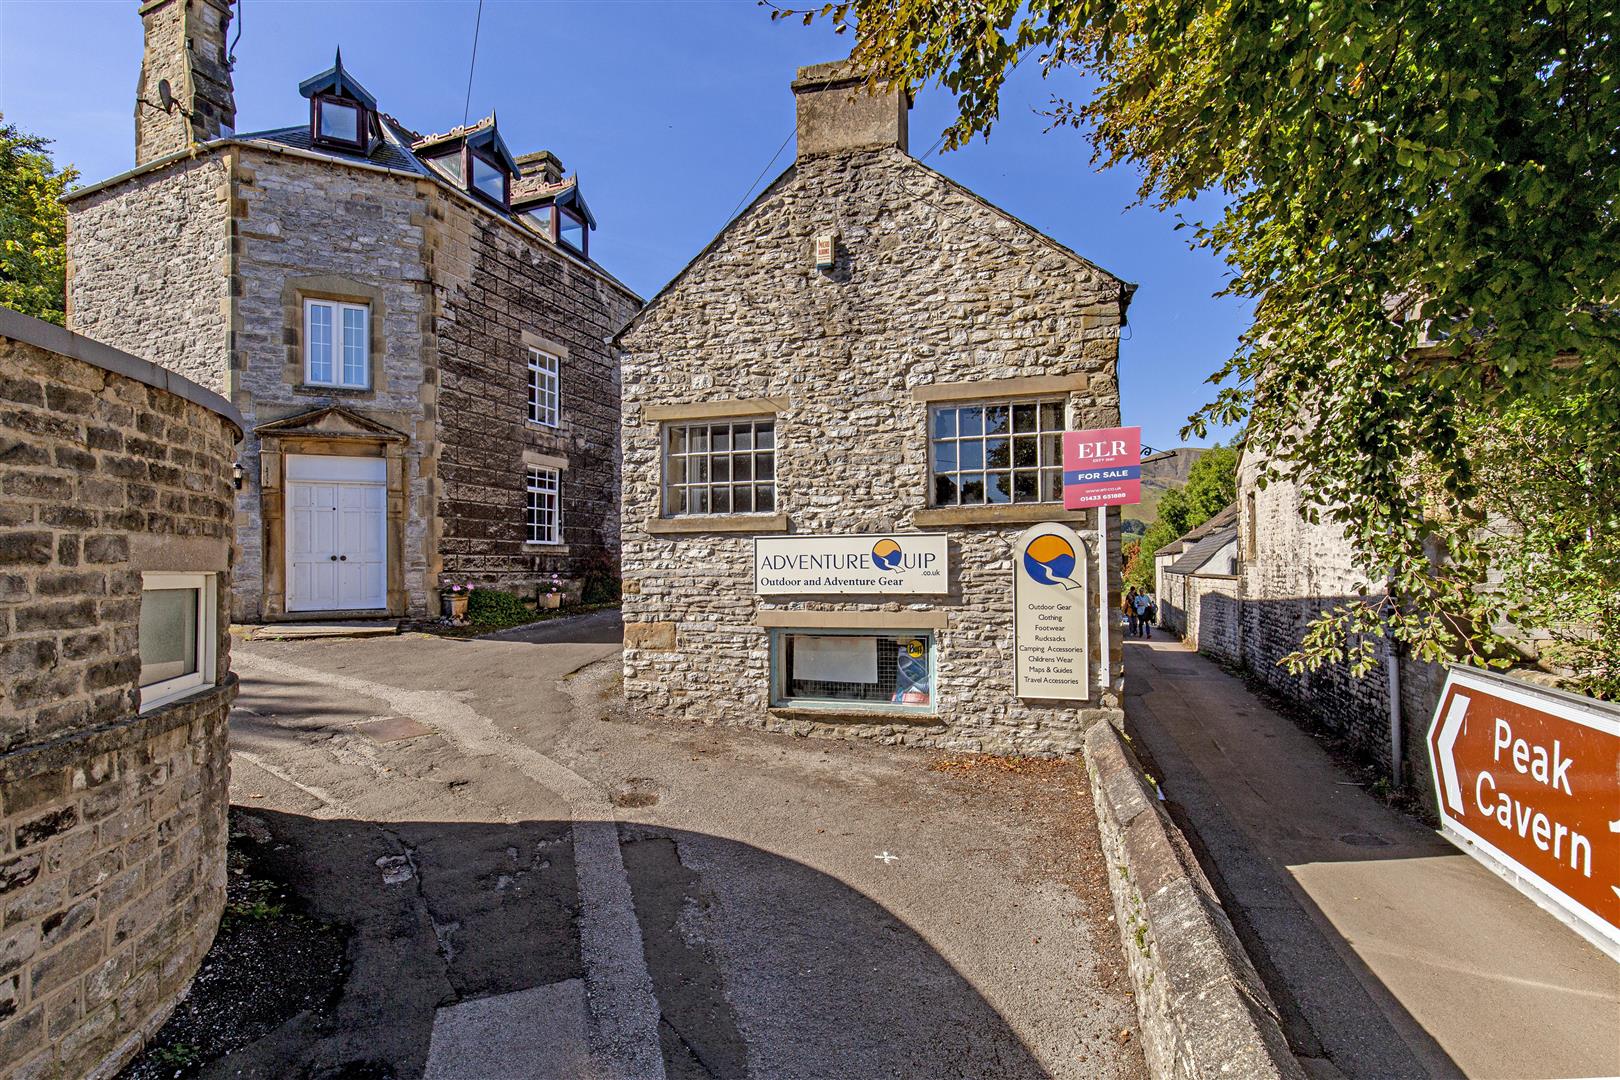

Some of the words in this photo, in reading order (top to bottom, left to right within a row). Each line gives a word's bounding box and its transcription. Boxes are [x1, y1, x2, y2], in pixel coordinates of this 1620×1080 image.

[1078, 440, 1128, 459] ELR
[1078, 472, 1100, 480] FOR
[1103, 470, 1129, 478] SALE
[760, 576, 802, 587] Outdoor
[803, 576, 822, 587] and
[824, 576, 876, 587] Adventure
[878, 576, 904, 587] Gear
[1028, 603, 1055, 611] Outdoor
[1056, 603, 1072, 611] Gear
[1038, 613, 1063, 622] Clothing
[1034, 624, 1065, 632] Footwear
[1019, 644, 1045, 653] Camping
[1047, 645, 1084, 653] Accessories
[1028, 655, 1055, 663] Childrens
[1028, 666, 1045, 674] Maps
[1052, 666, 1073, 674] Guides
[1043, 676, 1079, 685] Accessories
[1493, 718, 1573, 796] Peak
[1475, 770, 1592, 878] Cavern
